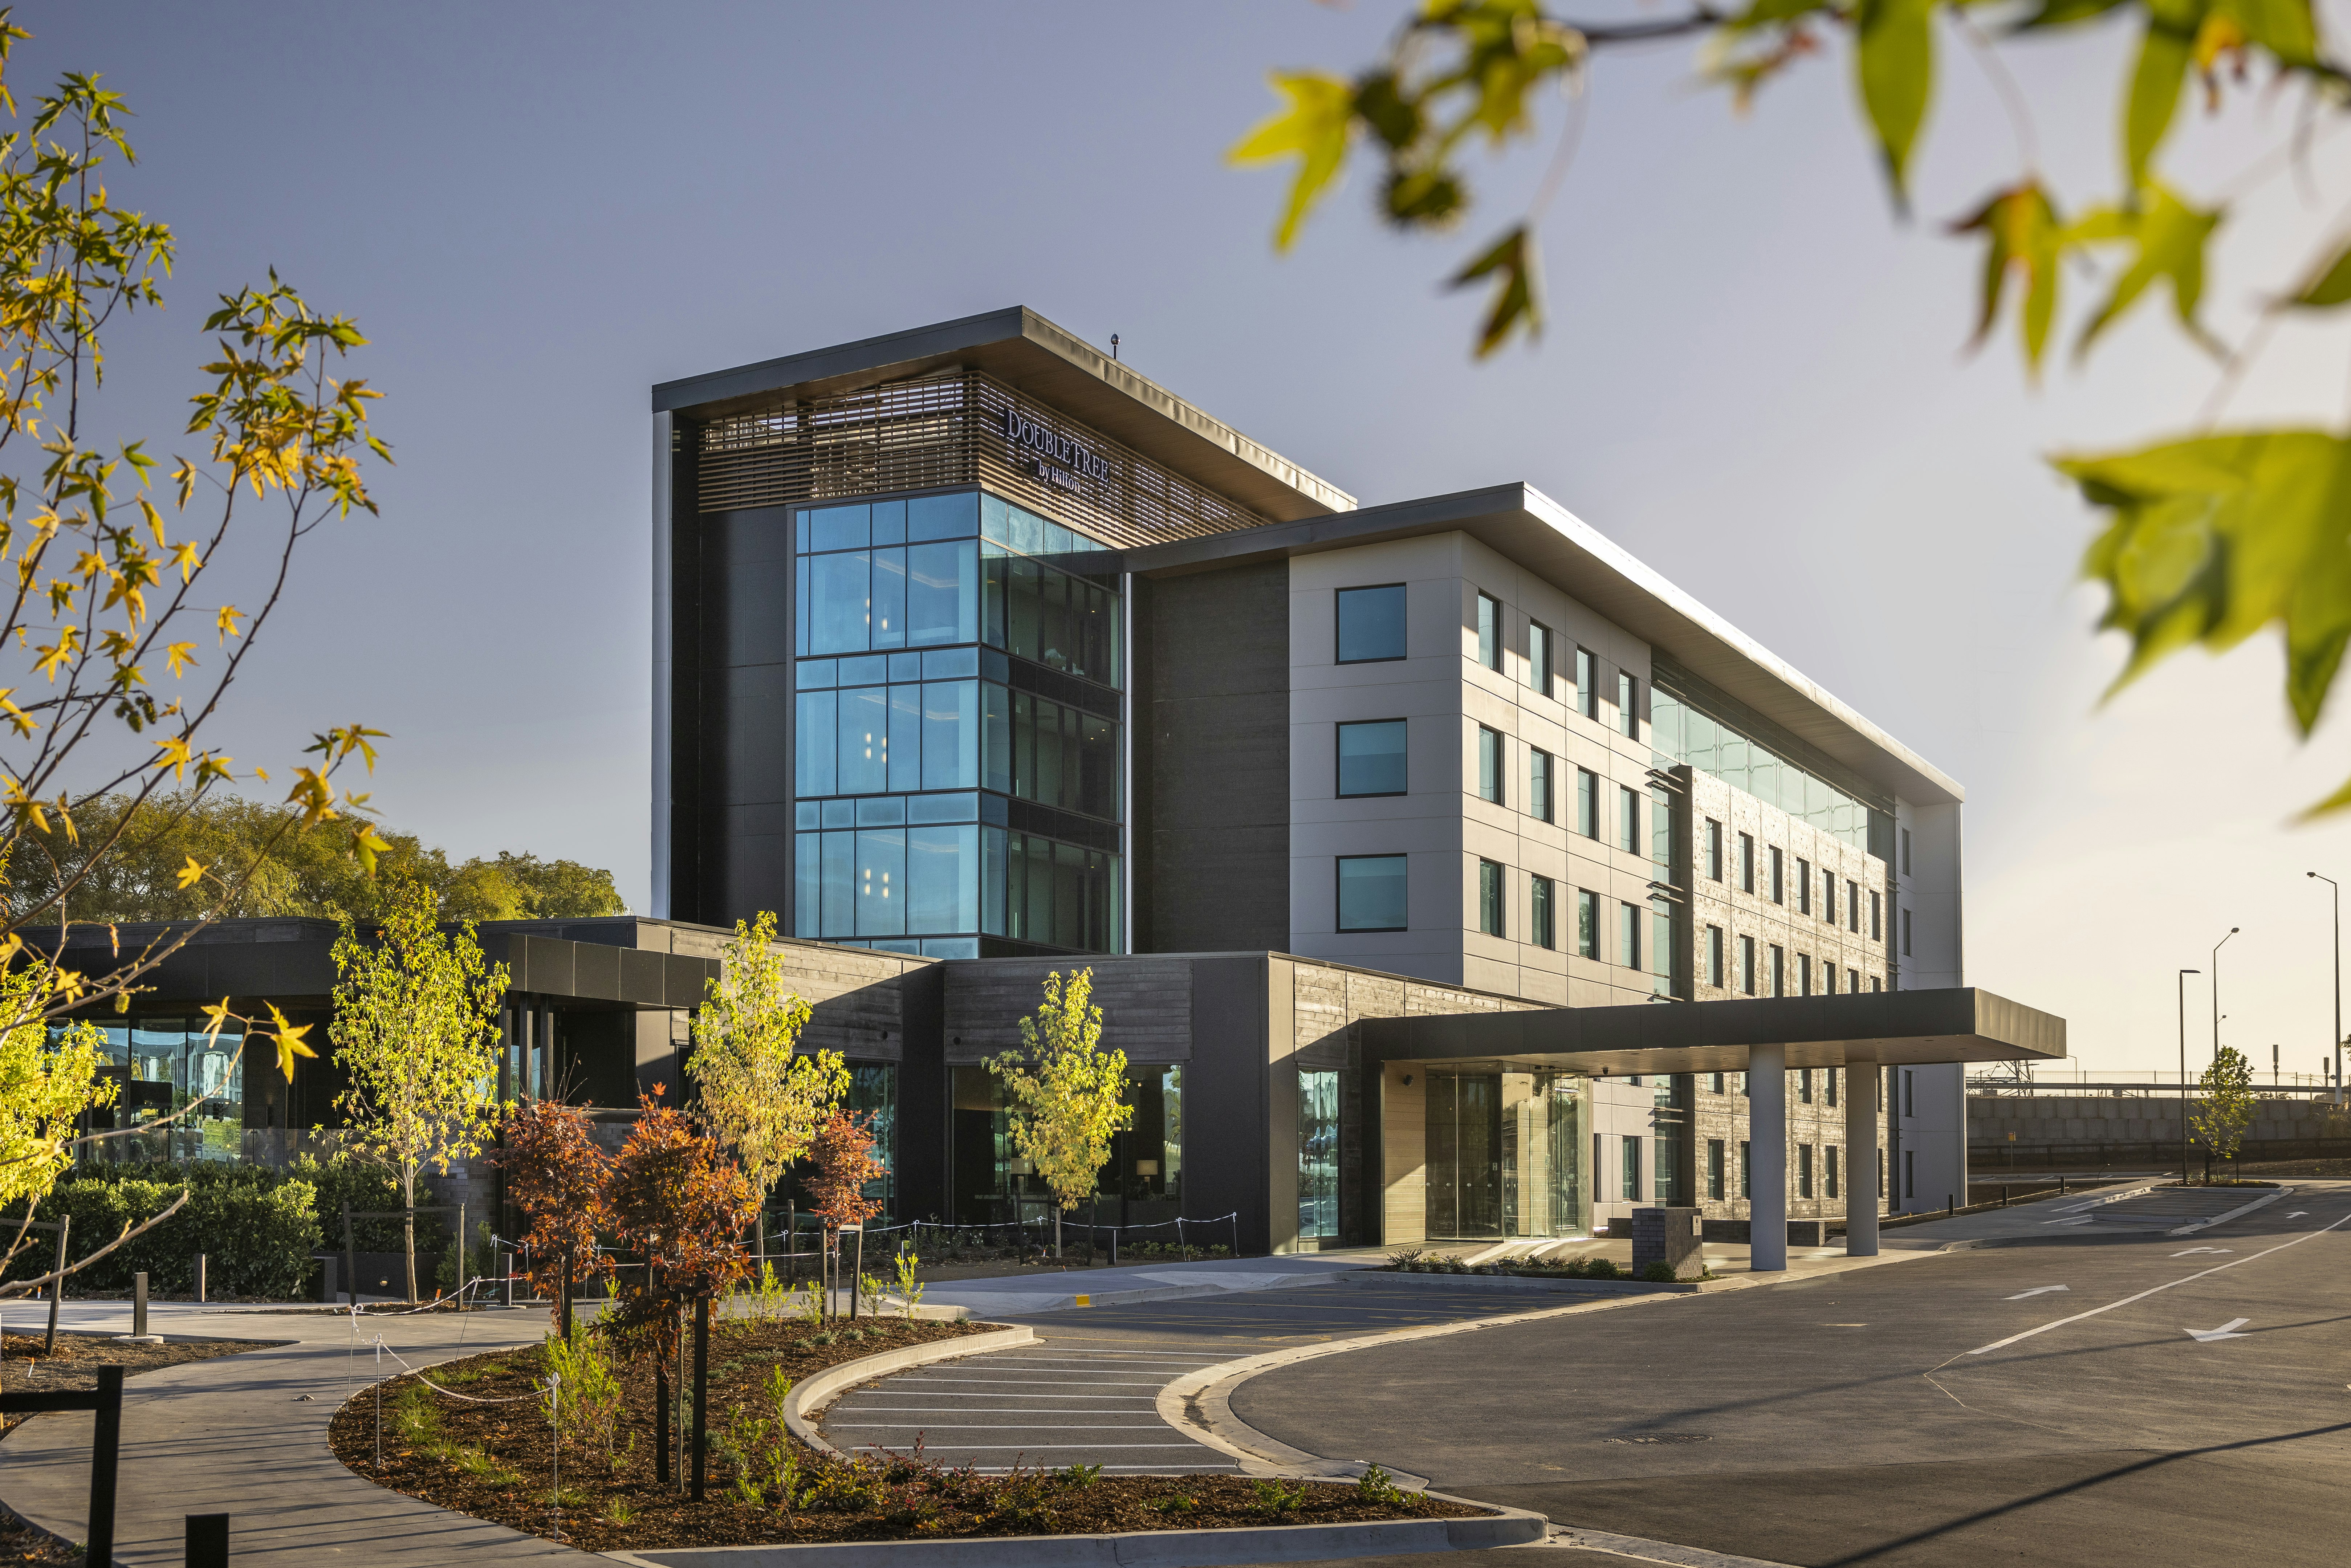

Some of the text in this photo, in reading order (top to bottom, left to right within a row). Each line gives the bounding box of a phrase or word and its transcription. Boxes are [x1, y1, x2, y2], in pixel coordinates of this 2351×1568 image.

[1008, 409, 1109, 482] DOUBLETREE
[1039, 460, 1080, 494] by Hilton
